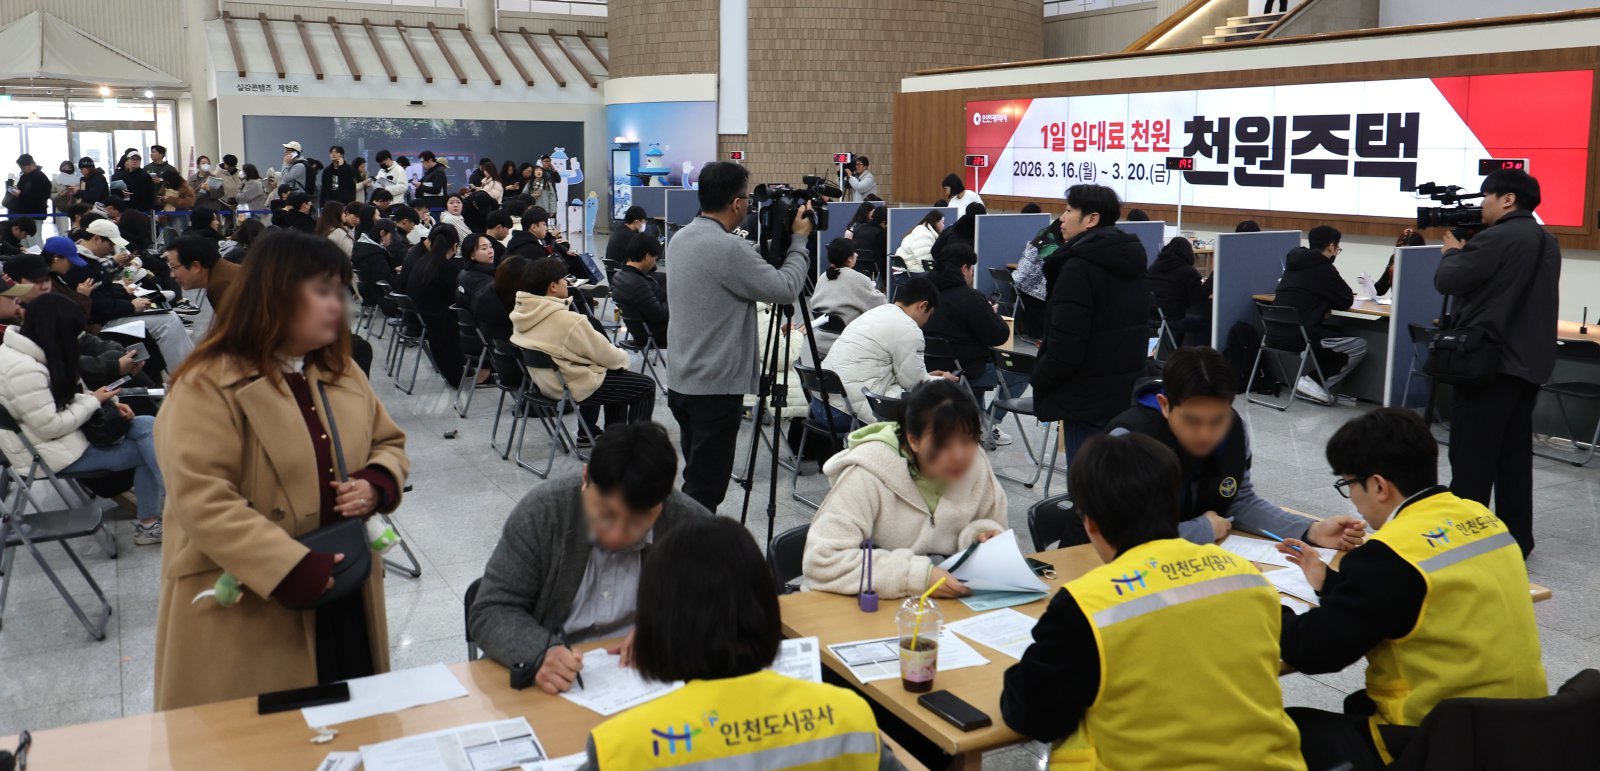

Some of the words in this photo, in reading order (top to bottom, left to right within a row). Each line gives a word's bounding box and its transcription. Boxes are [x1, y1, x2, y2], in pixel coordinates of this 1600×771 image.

[1041, 121, 1066, 152] 1일
[1071, 120, 1125, 152] 임대료
[1131, 119, 1170, 152] 천원
[1183, 112, 1420, 192] 천원주택
[1013, 161, 1045, 177] 2026.
[1048, 161, 1058, 178] 3.
[1061, 161, 1097, 183] 16.(월)
[1112, 162, 1124, 180] 3.
[1128, 163, 1171, 185] 20.(금)
[1161, 554, 1238, 581] 인천도시공사
[720, 704, 835, 747] 인천도시공사
